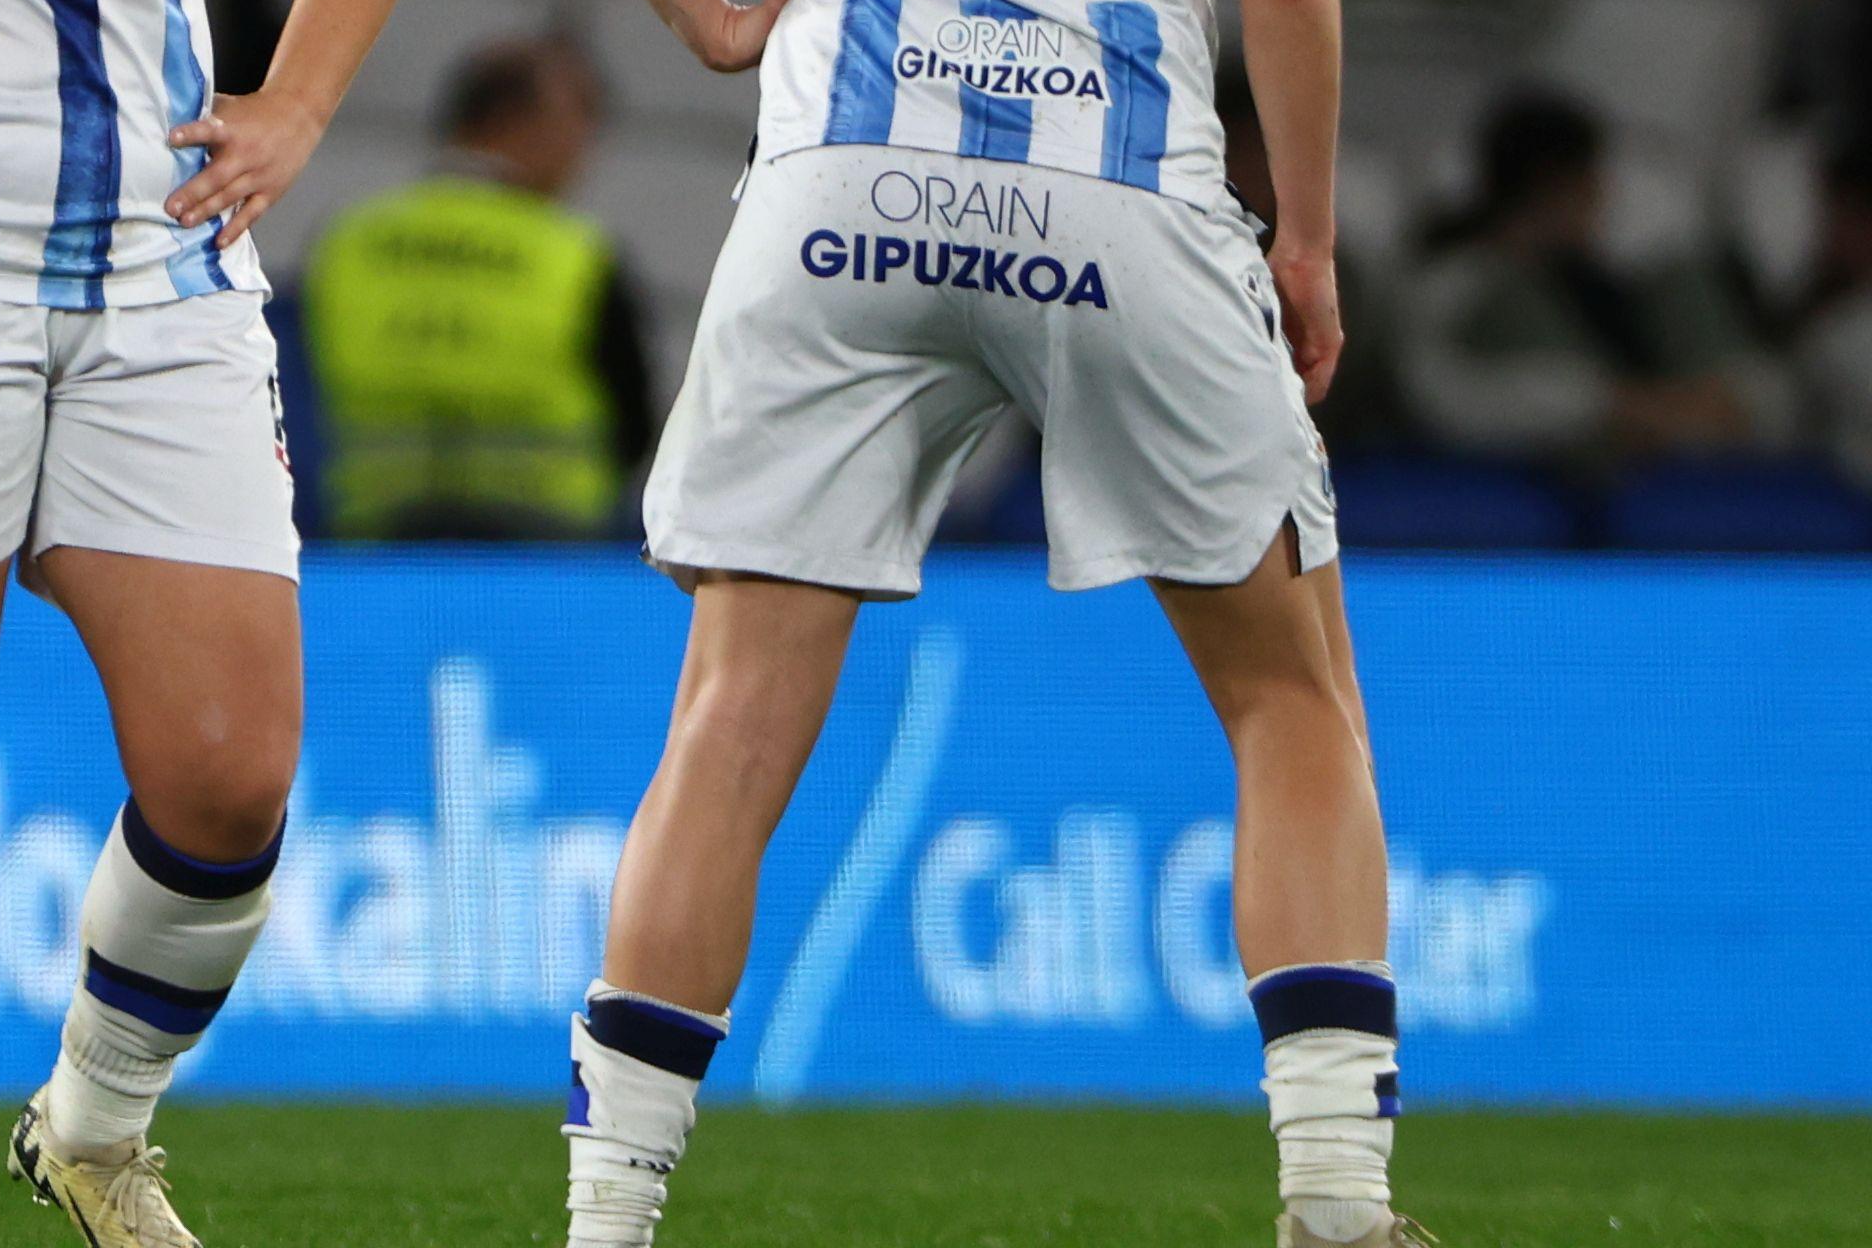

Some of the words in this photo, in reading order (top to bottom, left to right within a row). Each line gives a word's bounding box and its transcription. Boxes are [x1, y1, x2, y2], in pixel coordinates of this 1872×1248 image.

[897, 45, 1105, 101] GIPUZKOA
[937, 18, 1063, 58] ORAIN
[871, 170, 1050, 242] ORAIN
[800, 228, 1108, 310] GIPUZKOA
[912, 804, 1144, 1022] Call
